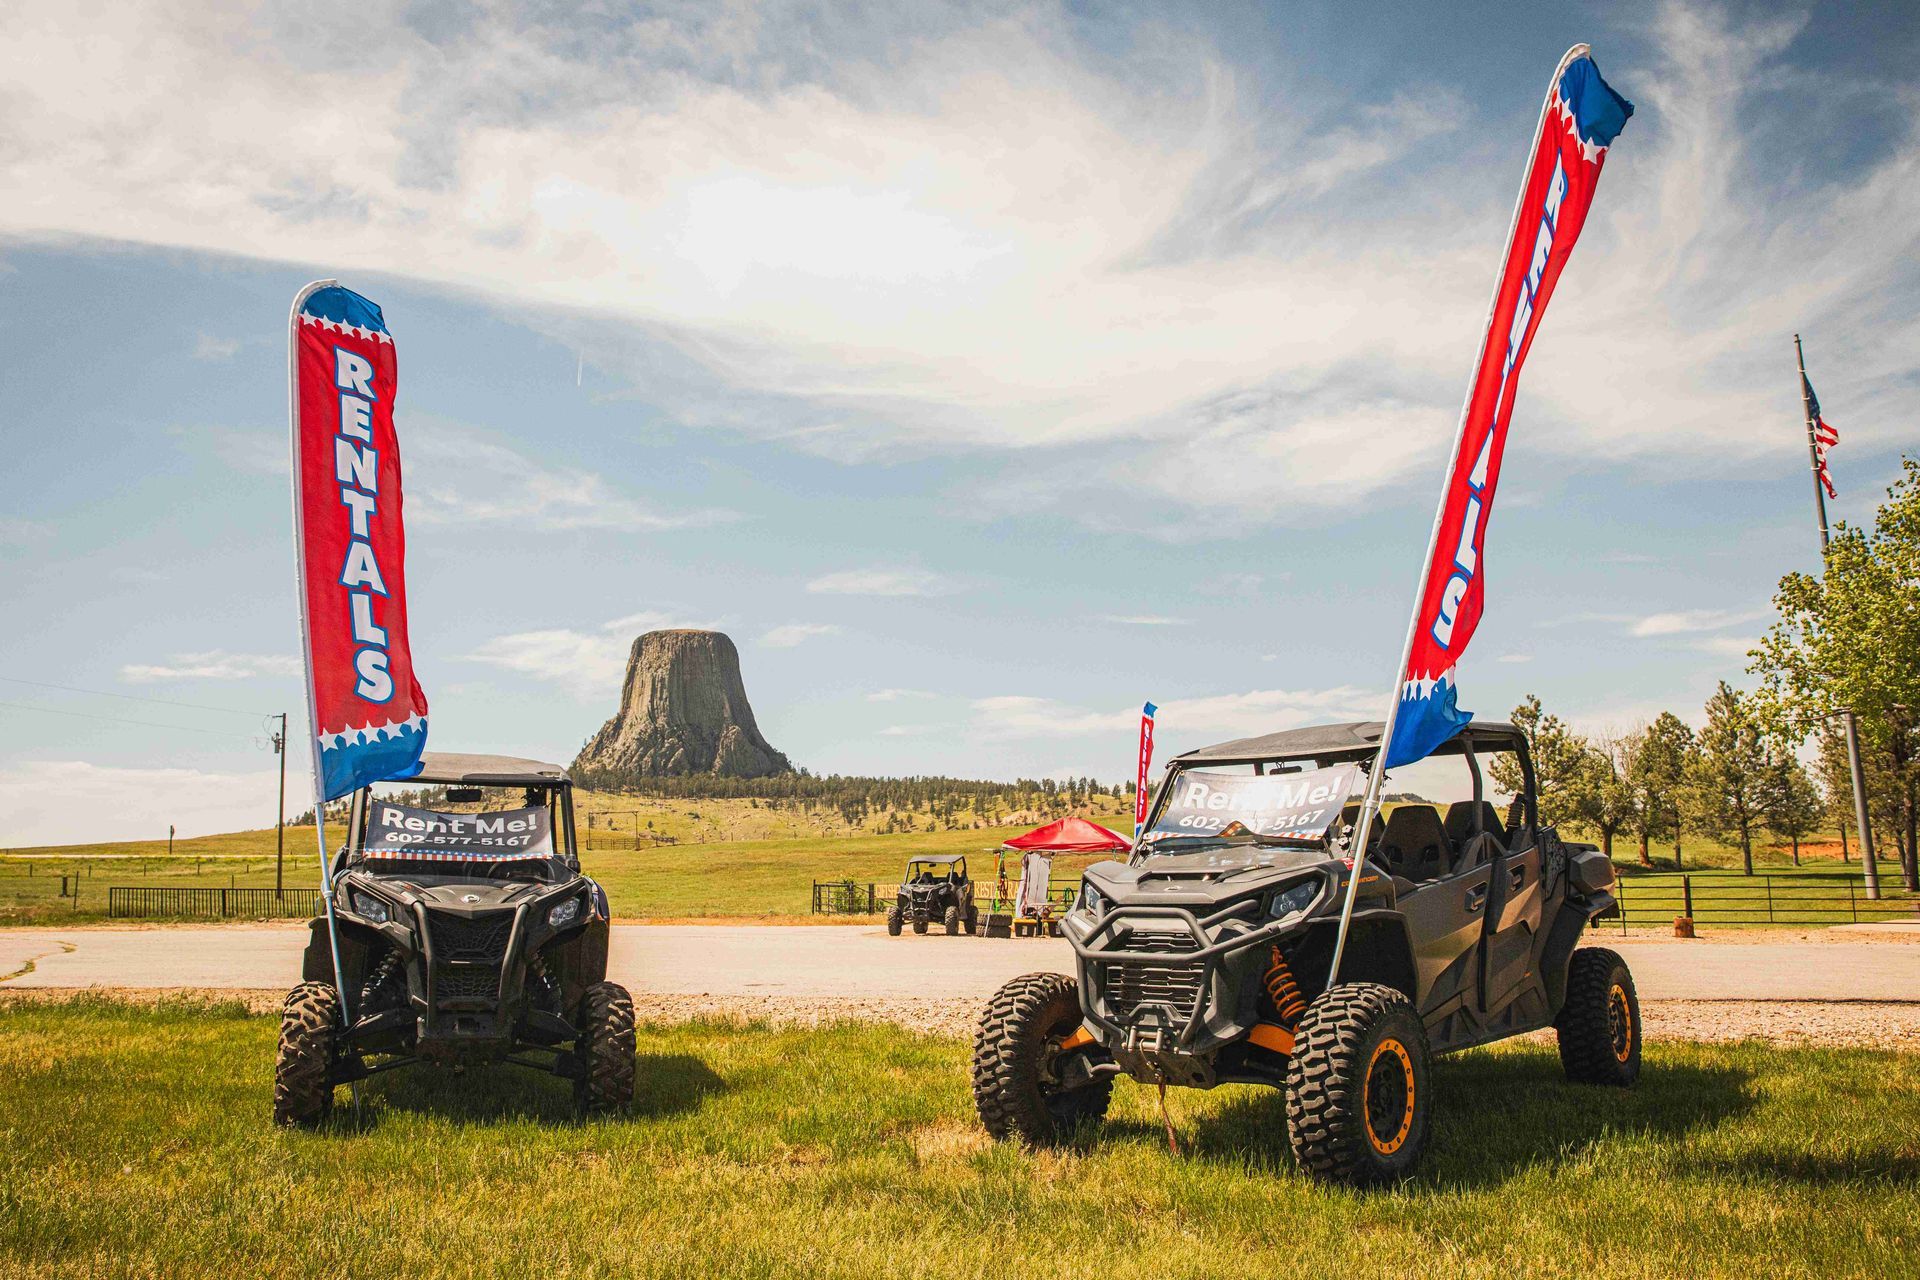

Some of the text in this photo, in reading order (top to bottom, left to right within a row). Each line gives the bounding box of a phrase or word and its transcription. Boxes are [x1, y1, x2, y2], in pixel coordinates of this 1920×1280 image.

[334, 345, 395, 703] RENTALS
[1276, 776, 1343, 809] Me!
[381, 807, 538, 835] Rent Me!
[385, 831, 532, 847] 602-577-5167
